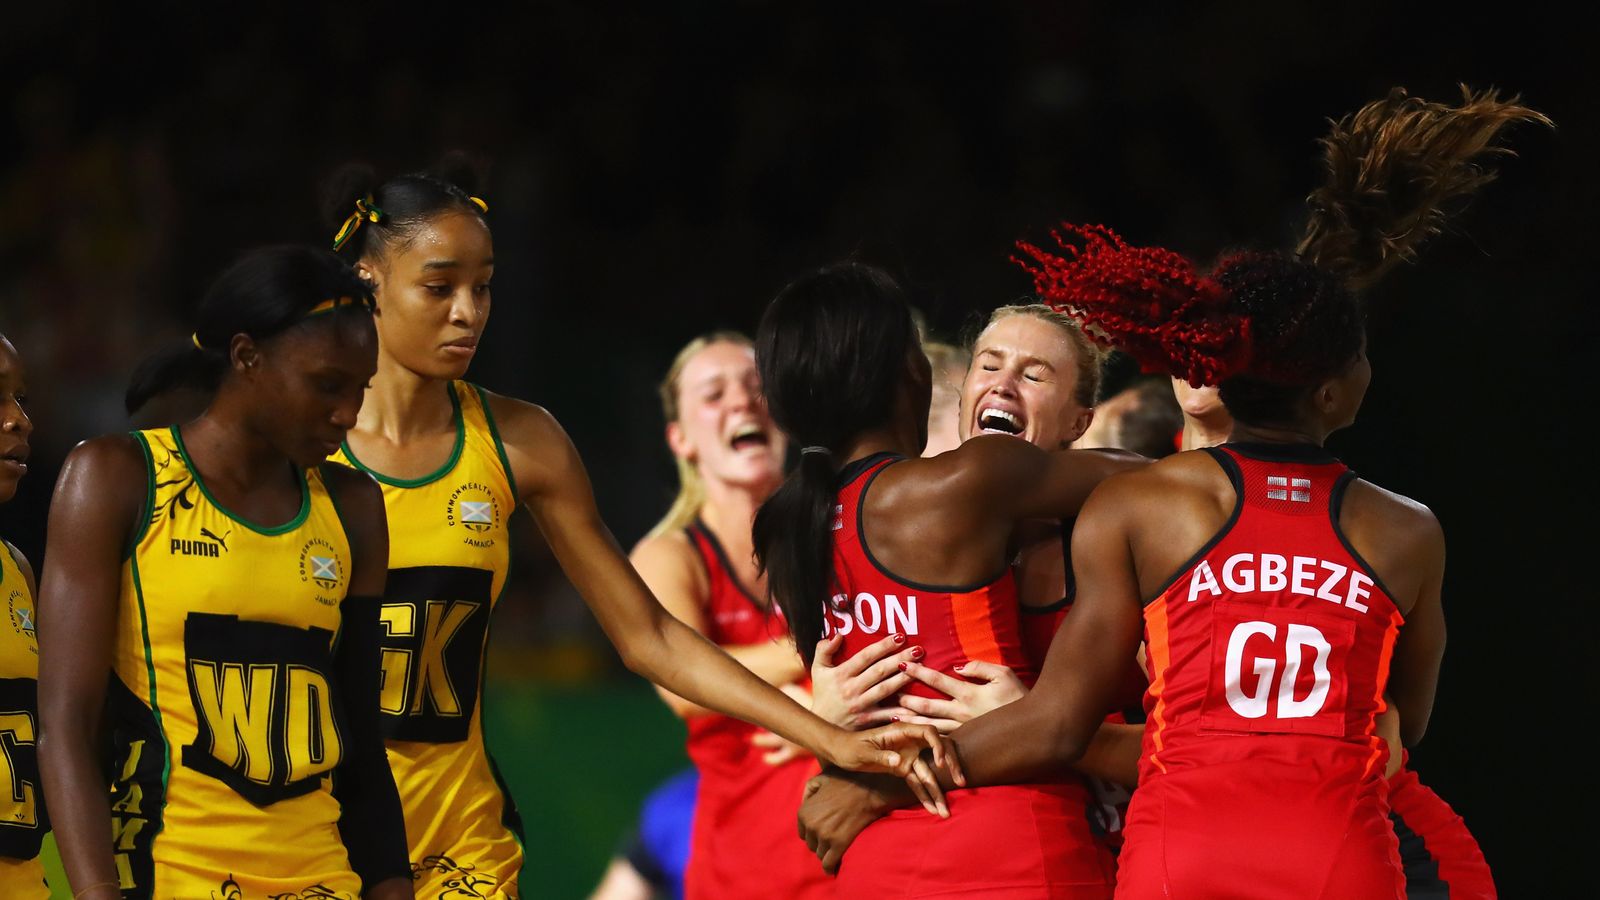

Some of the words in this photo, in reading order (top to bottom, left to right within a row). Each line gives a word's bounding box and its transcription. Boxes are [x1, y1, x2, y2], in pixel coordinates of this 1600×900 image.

[447, 482, 492, 527] COMMONWEALTH
[170, 538, 220, 558] PUMA
[463, 537, 495, 548] JAMAICA
[1187, 552, 1375, 615] AGBEZE
[820, 591, 919, 639] SON
[379, 599, 481, 717] GK
[1224, 620, 1332, 719] GD
[189, 657, 345, 787] WD
